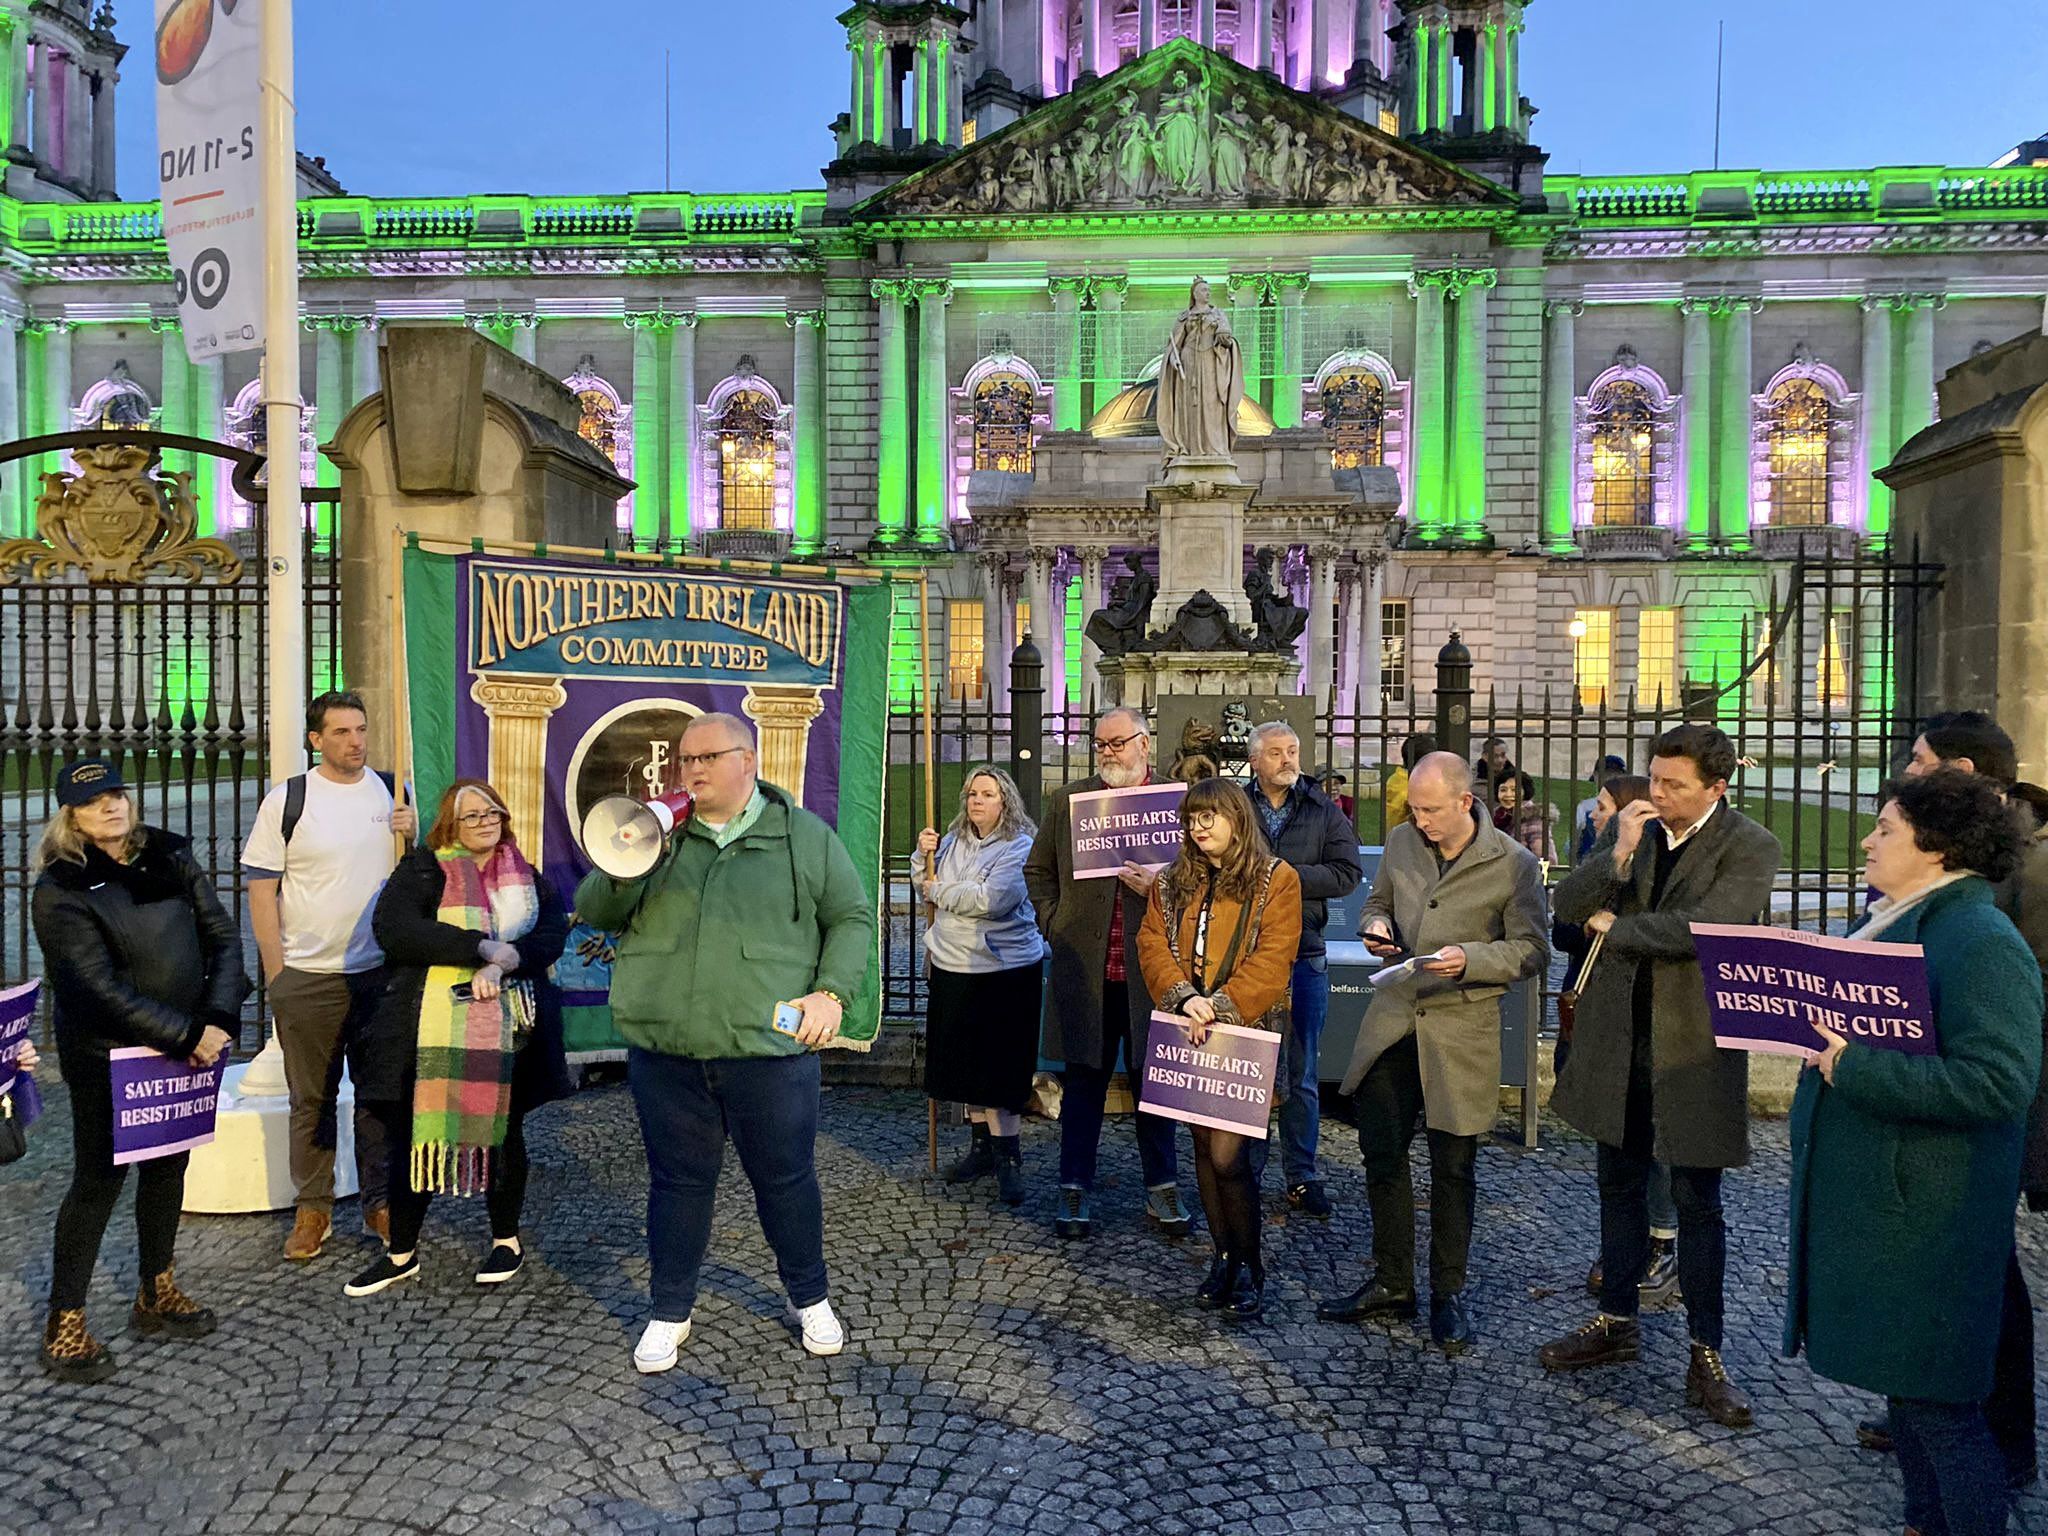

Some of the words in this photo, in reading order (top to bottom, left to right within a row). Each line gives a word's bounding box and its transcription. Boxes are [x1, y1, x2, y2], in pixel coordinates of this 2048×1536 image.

[477, 571, 679, 667] NORTHERN
[685, 583, 831, 667] IRELAND
[561, 635, 769, 672] COMMITTEE
[1080, 816, 1112, 832] SAVE
[1112, 813, 1139, 828] THE
[1141, 809, 1180, 825] ARTS,
[1077, 835, 1121, 852] RESIST
[1122, 832, 1149, 847] THE
[1151, 829, 1185, 844] CUTS
[1781, 930, 1820, 944] EQUITY
[1717, 962, 1779, 985] SAVE
[1780, 968, 1828, 996] THE
[1831, 980, 1910, 1010] ARTS,
[1716, 991, 1799, 1018] RESIST
[1801, 1002, 1848, 1033] THE
[1851, 1015, 1924, 1039] CUTS
[1155, 1043, 1190, 1064] SAVE
[1190, 1050, 1220, 1070] THE
[1220, 1056, 1264, 1081] ARTS,
[124, 1079, 164, 1100] SAVE
[165, 1076, 191, 1095] THE
[190, 1071, 215, 1091] ARTS,
[1148, 1066, 1196, 1090] RESIST
[1196, 1076, 1226, 1096] THE
[1226, 1082, 1266, 1104] CUTS
[120, 1104, 173, 1128] RESIST
[173, 1100, 193, 1119] THE
[193, 1095, 216, 1114] CUTS
